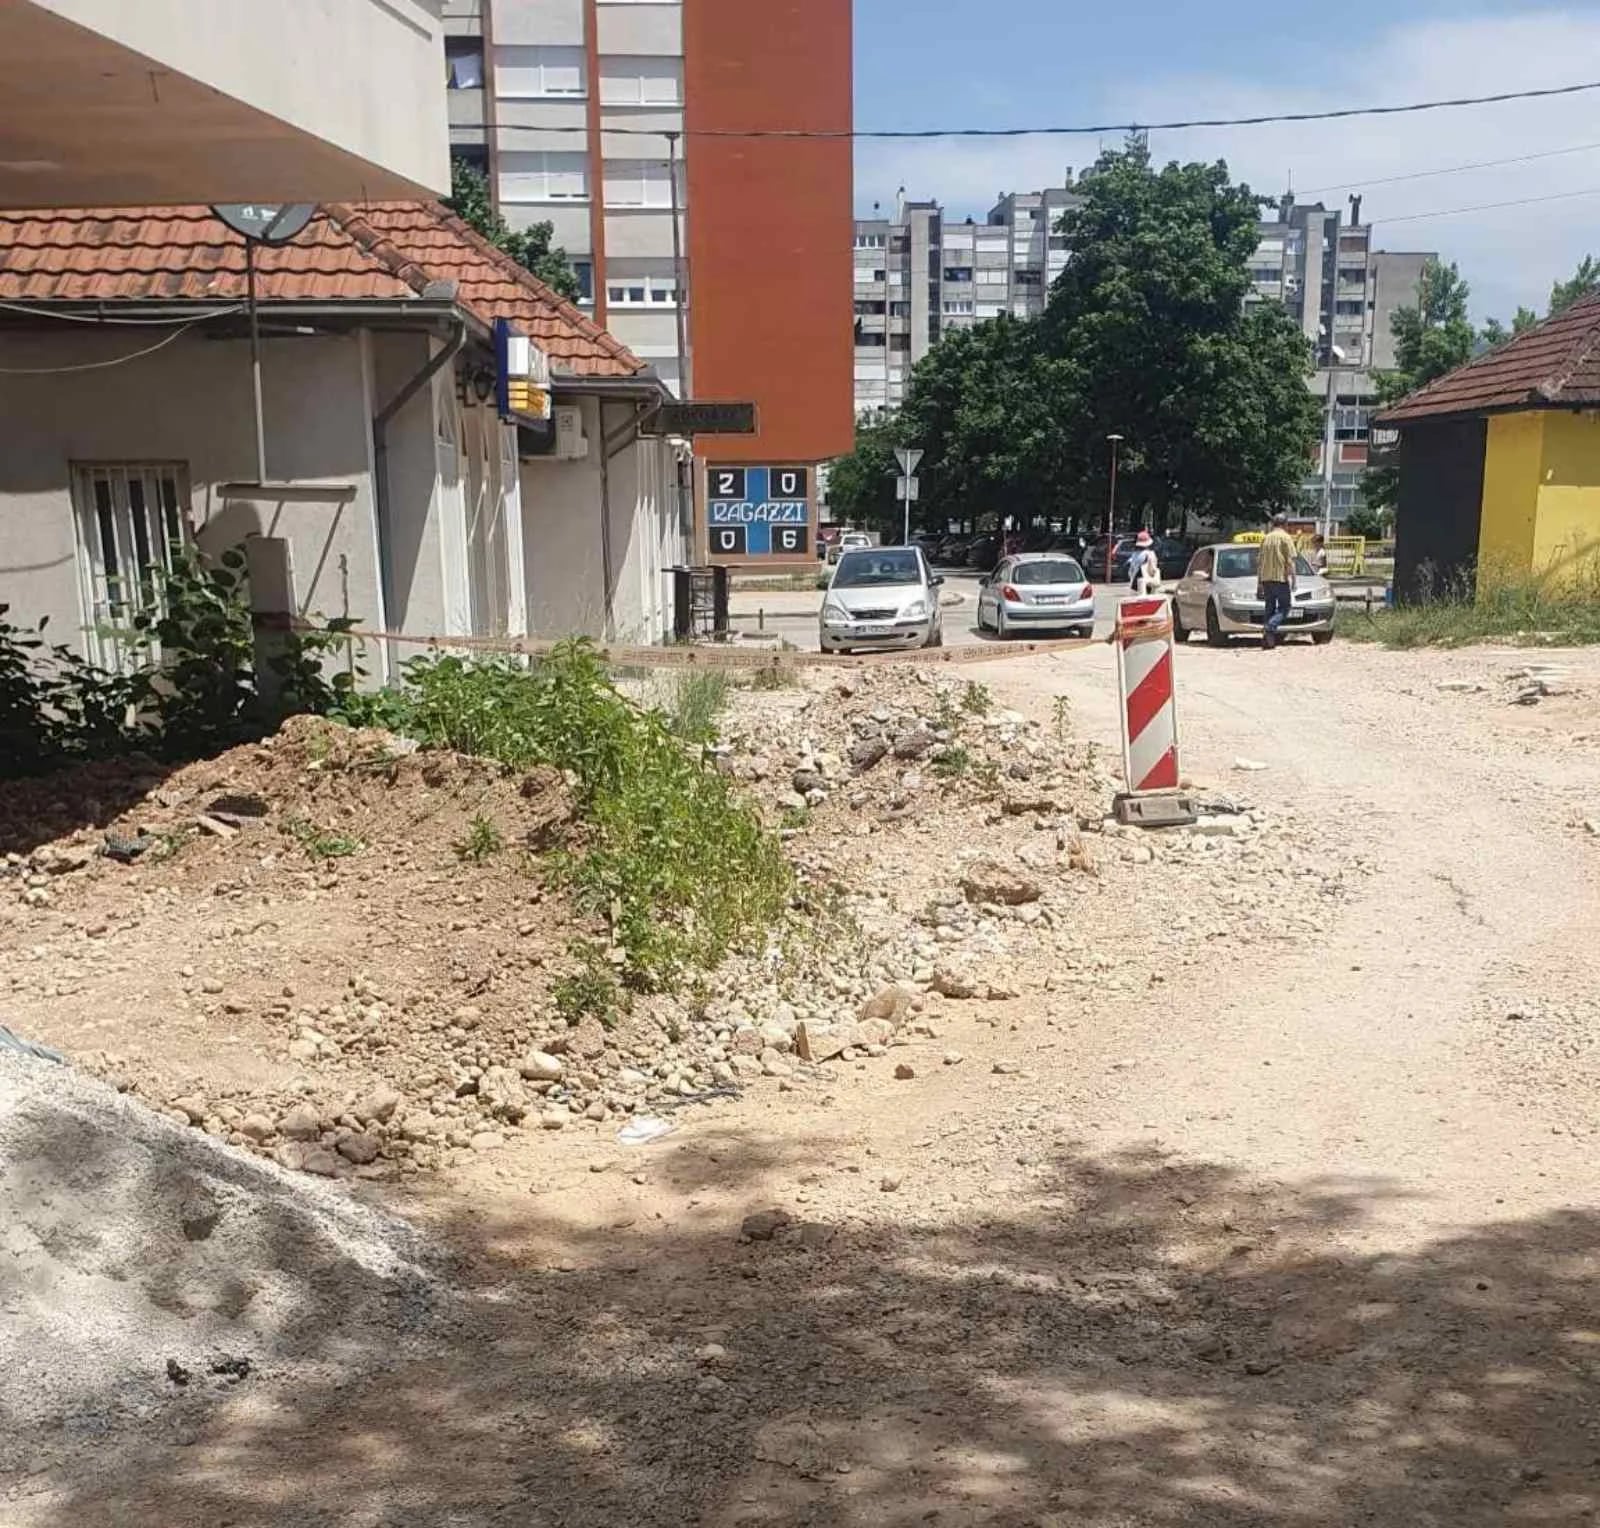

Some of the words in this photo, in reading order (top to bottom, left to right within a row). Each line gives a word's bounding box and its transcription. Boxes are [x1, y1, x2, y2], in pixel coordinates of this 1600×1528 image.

[719, 473, 734, 494] 2
[781, 473, 796, 493] 0
[713, 502, 803, 522] RAGAZZI
[720, 530, 736, 550] 0
[782, 530, 797, 549] 6
